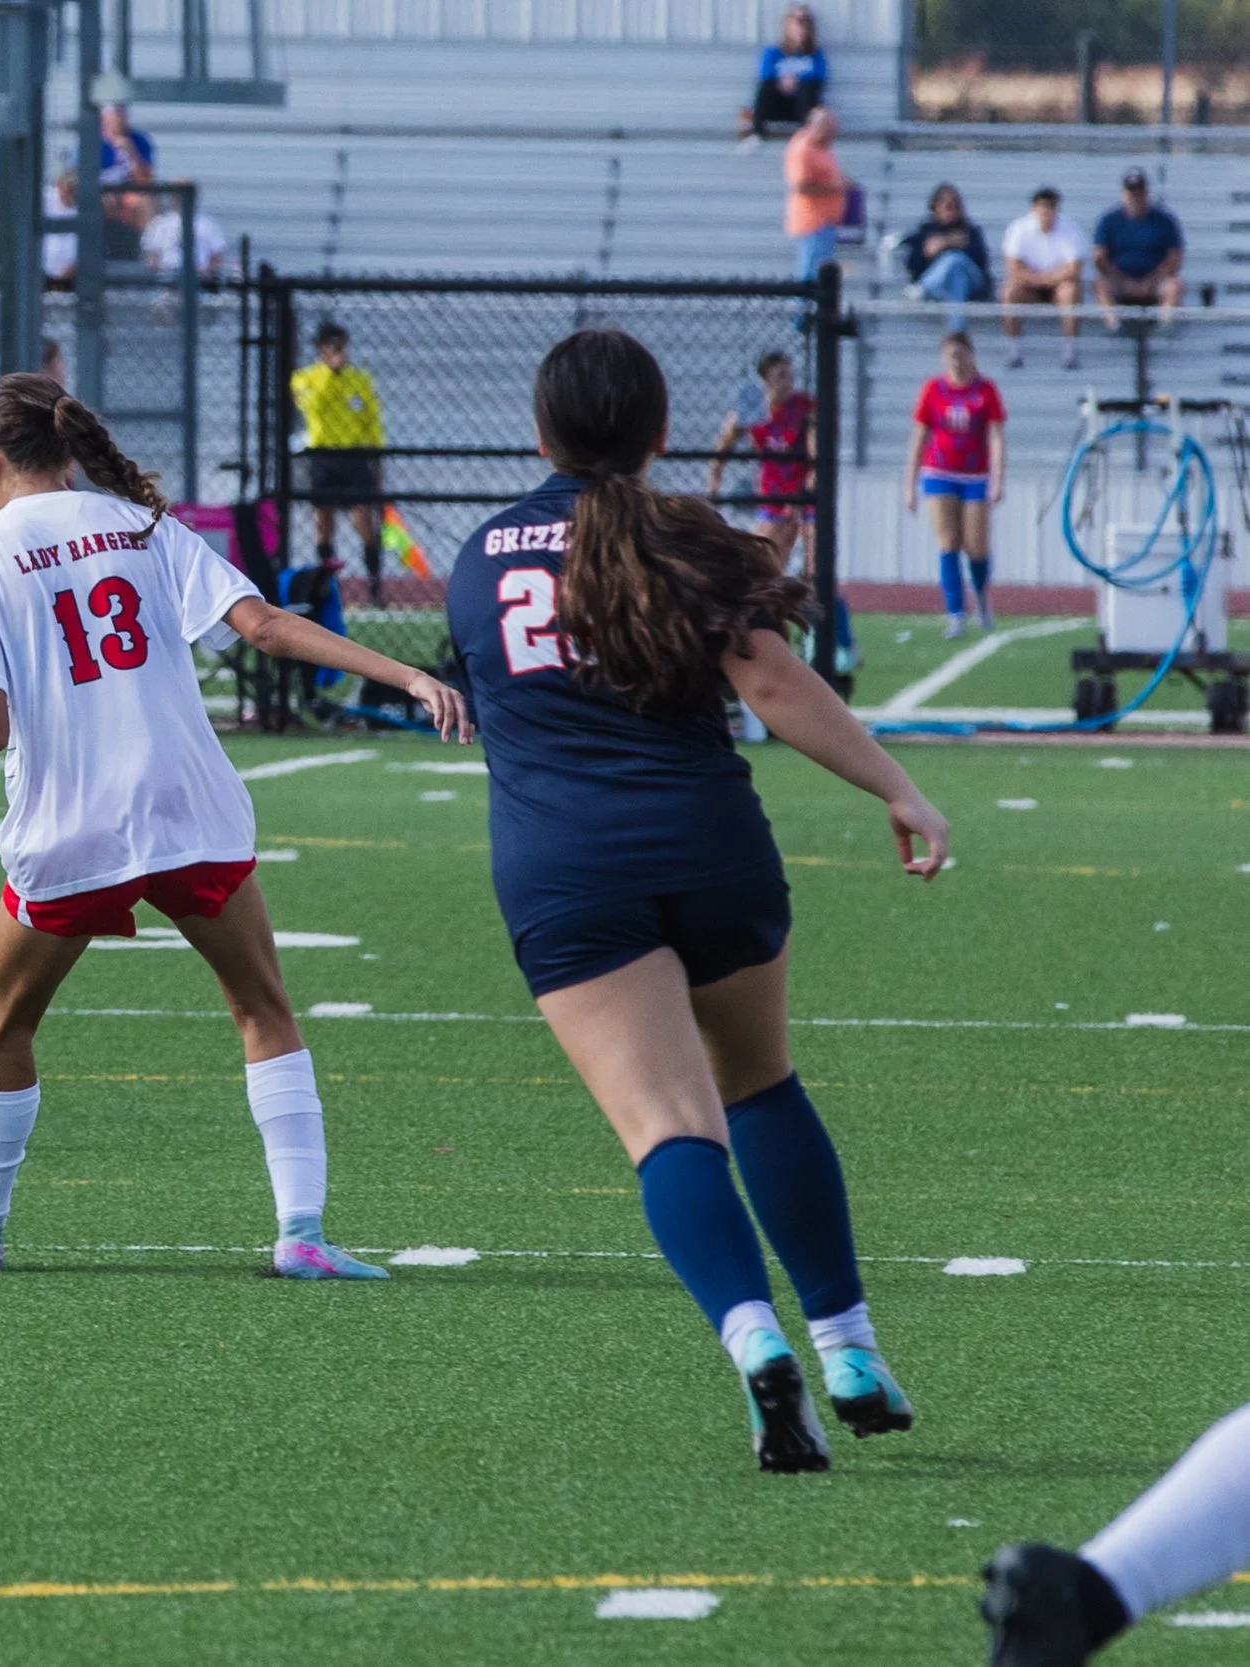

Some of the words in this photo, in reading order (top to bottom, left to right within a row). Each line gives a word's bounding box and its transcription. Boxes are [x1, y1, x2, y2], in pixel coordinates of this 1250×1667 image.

[484, 521, 572, 556] GRIZZ
[14, 545, 61, 575] LADY
[53, 576, 149, 686] 13
